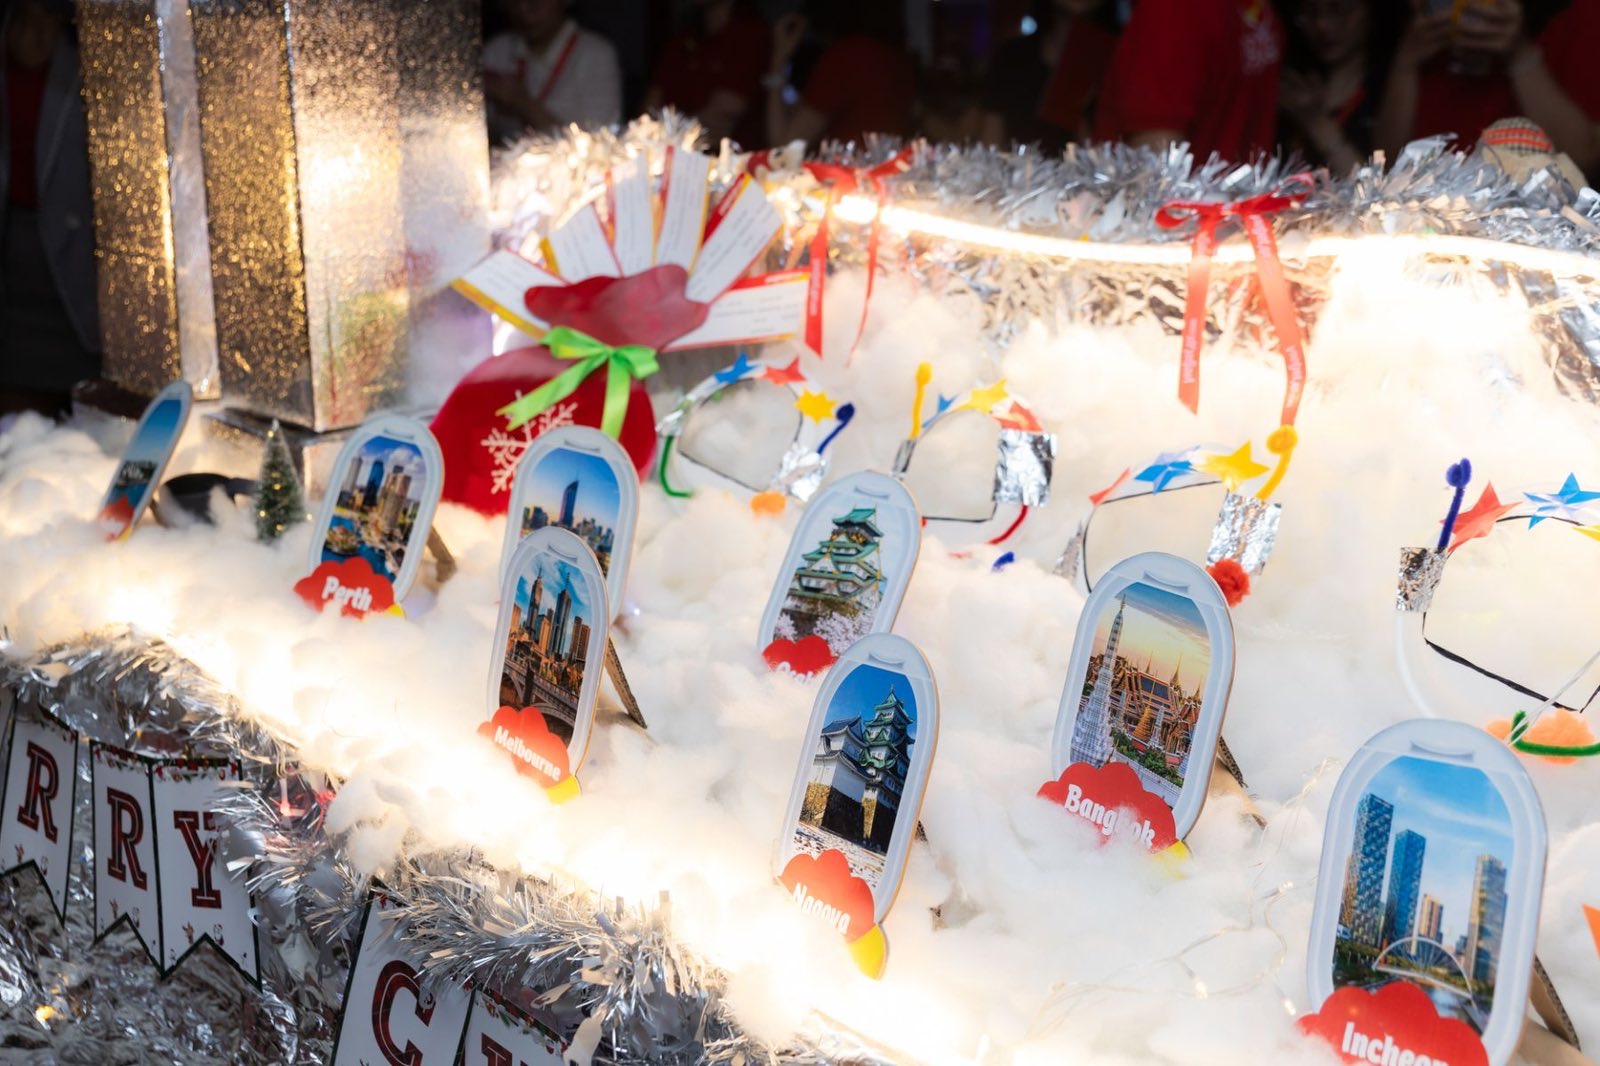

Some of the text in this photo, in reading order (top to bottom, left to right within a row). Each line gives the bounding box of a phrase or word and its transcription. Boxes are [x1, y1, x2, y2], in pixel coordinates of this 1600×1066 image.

[321, 575, 373, 612] Perth
[494, 725, 561, 782] Melbourne
[1064, 783, 1156, 847] Bangok
